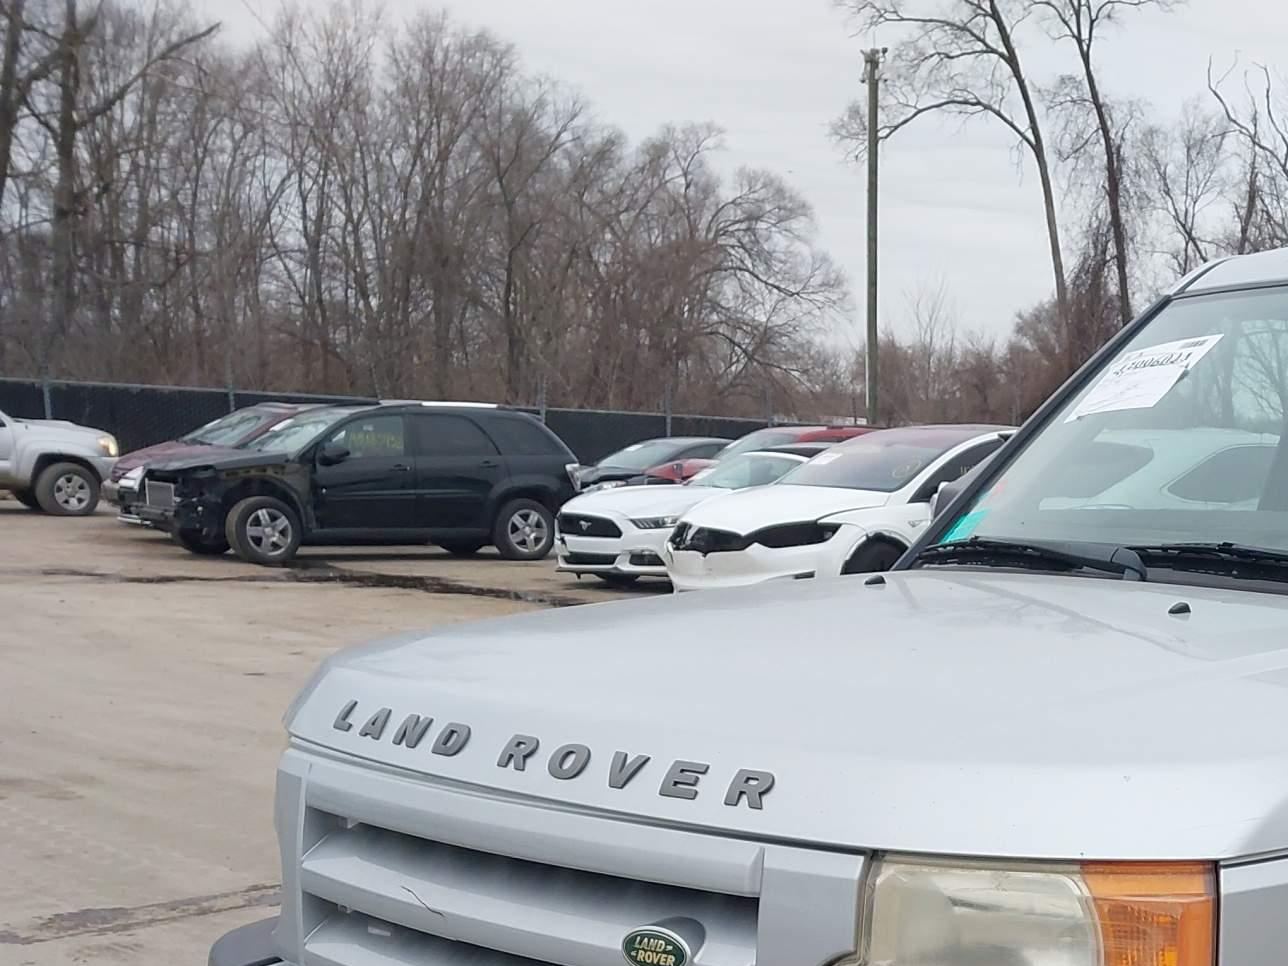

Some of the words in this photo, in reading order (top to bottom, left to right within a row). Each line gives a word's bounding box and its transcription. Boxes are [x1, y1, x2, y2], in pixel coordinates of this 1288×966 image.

[332, 699, 472, 757] LAND
[496, 733, 776, 810] ROVER
[634, 936, 665, 951] LAND
[637, 950, 676, 966] ROVER
